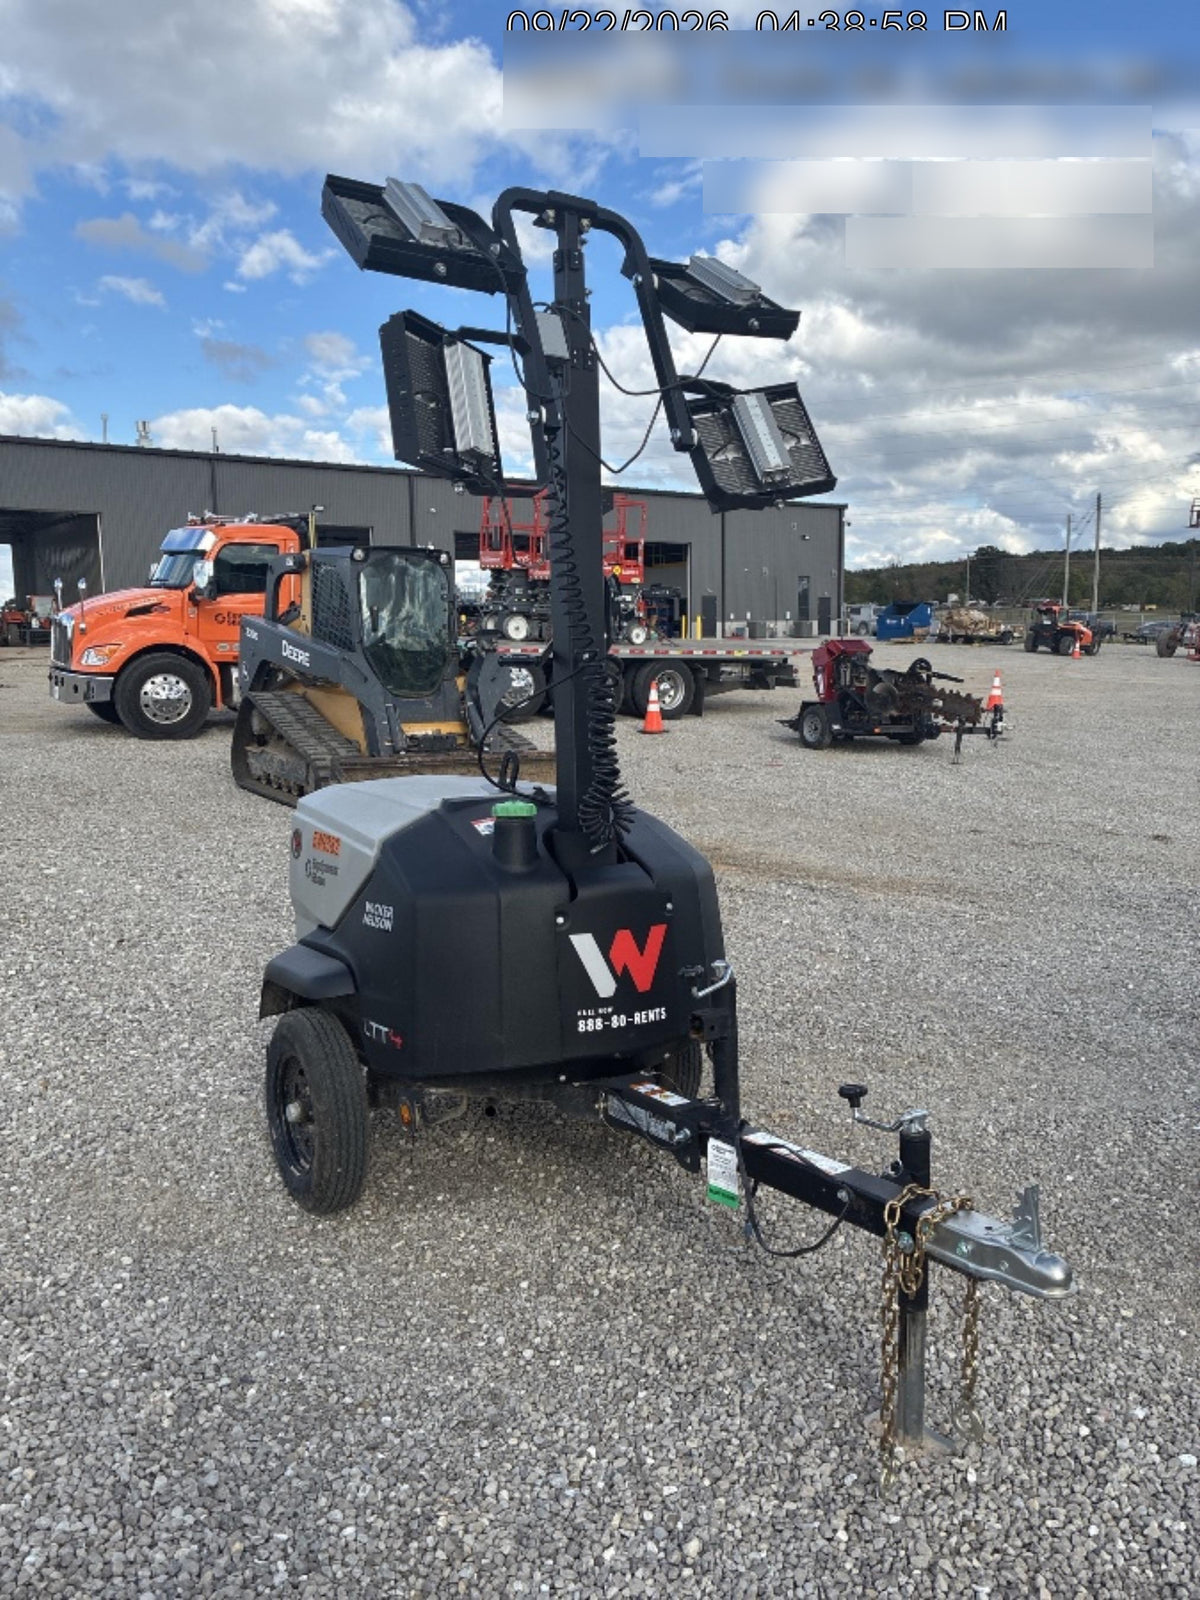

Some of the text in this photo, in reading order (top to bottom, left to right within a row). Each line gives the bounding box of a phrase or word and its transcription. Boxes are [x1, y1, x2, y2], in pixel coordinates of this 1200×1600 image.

[282, 640, 310, 667] DEERE
[362, 913, 394, 932] NELSON
[577, 1007, 667, 1032] 888-80-RENTS
[363, 1018, 403, 1049] LTT4
